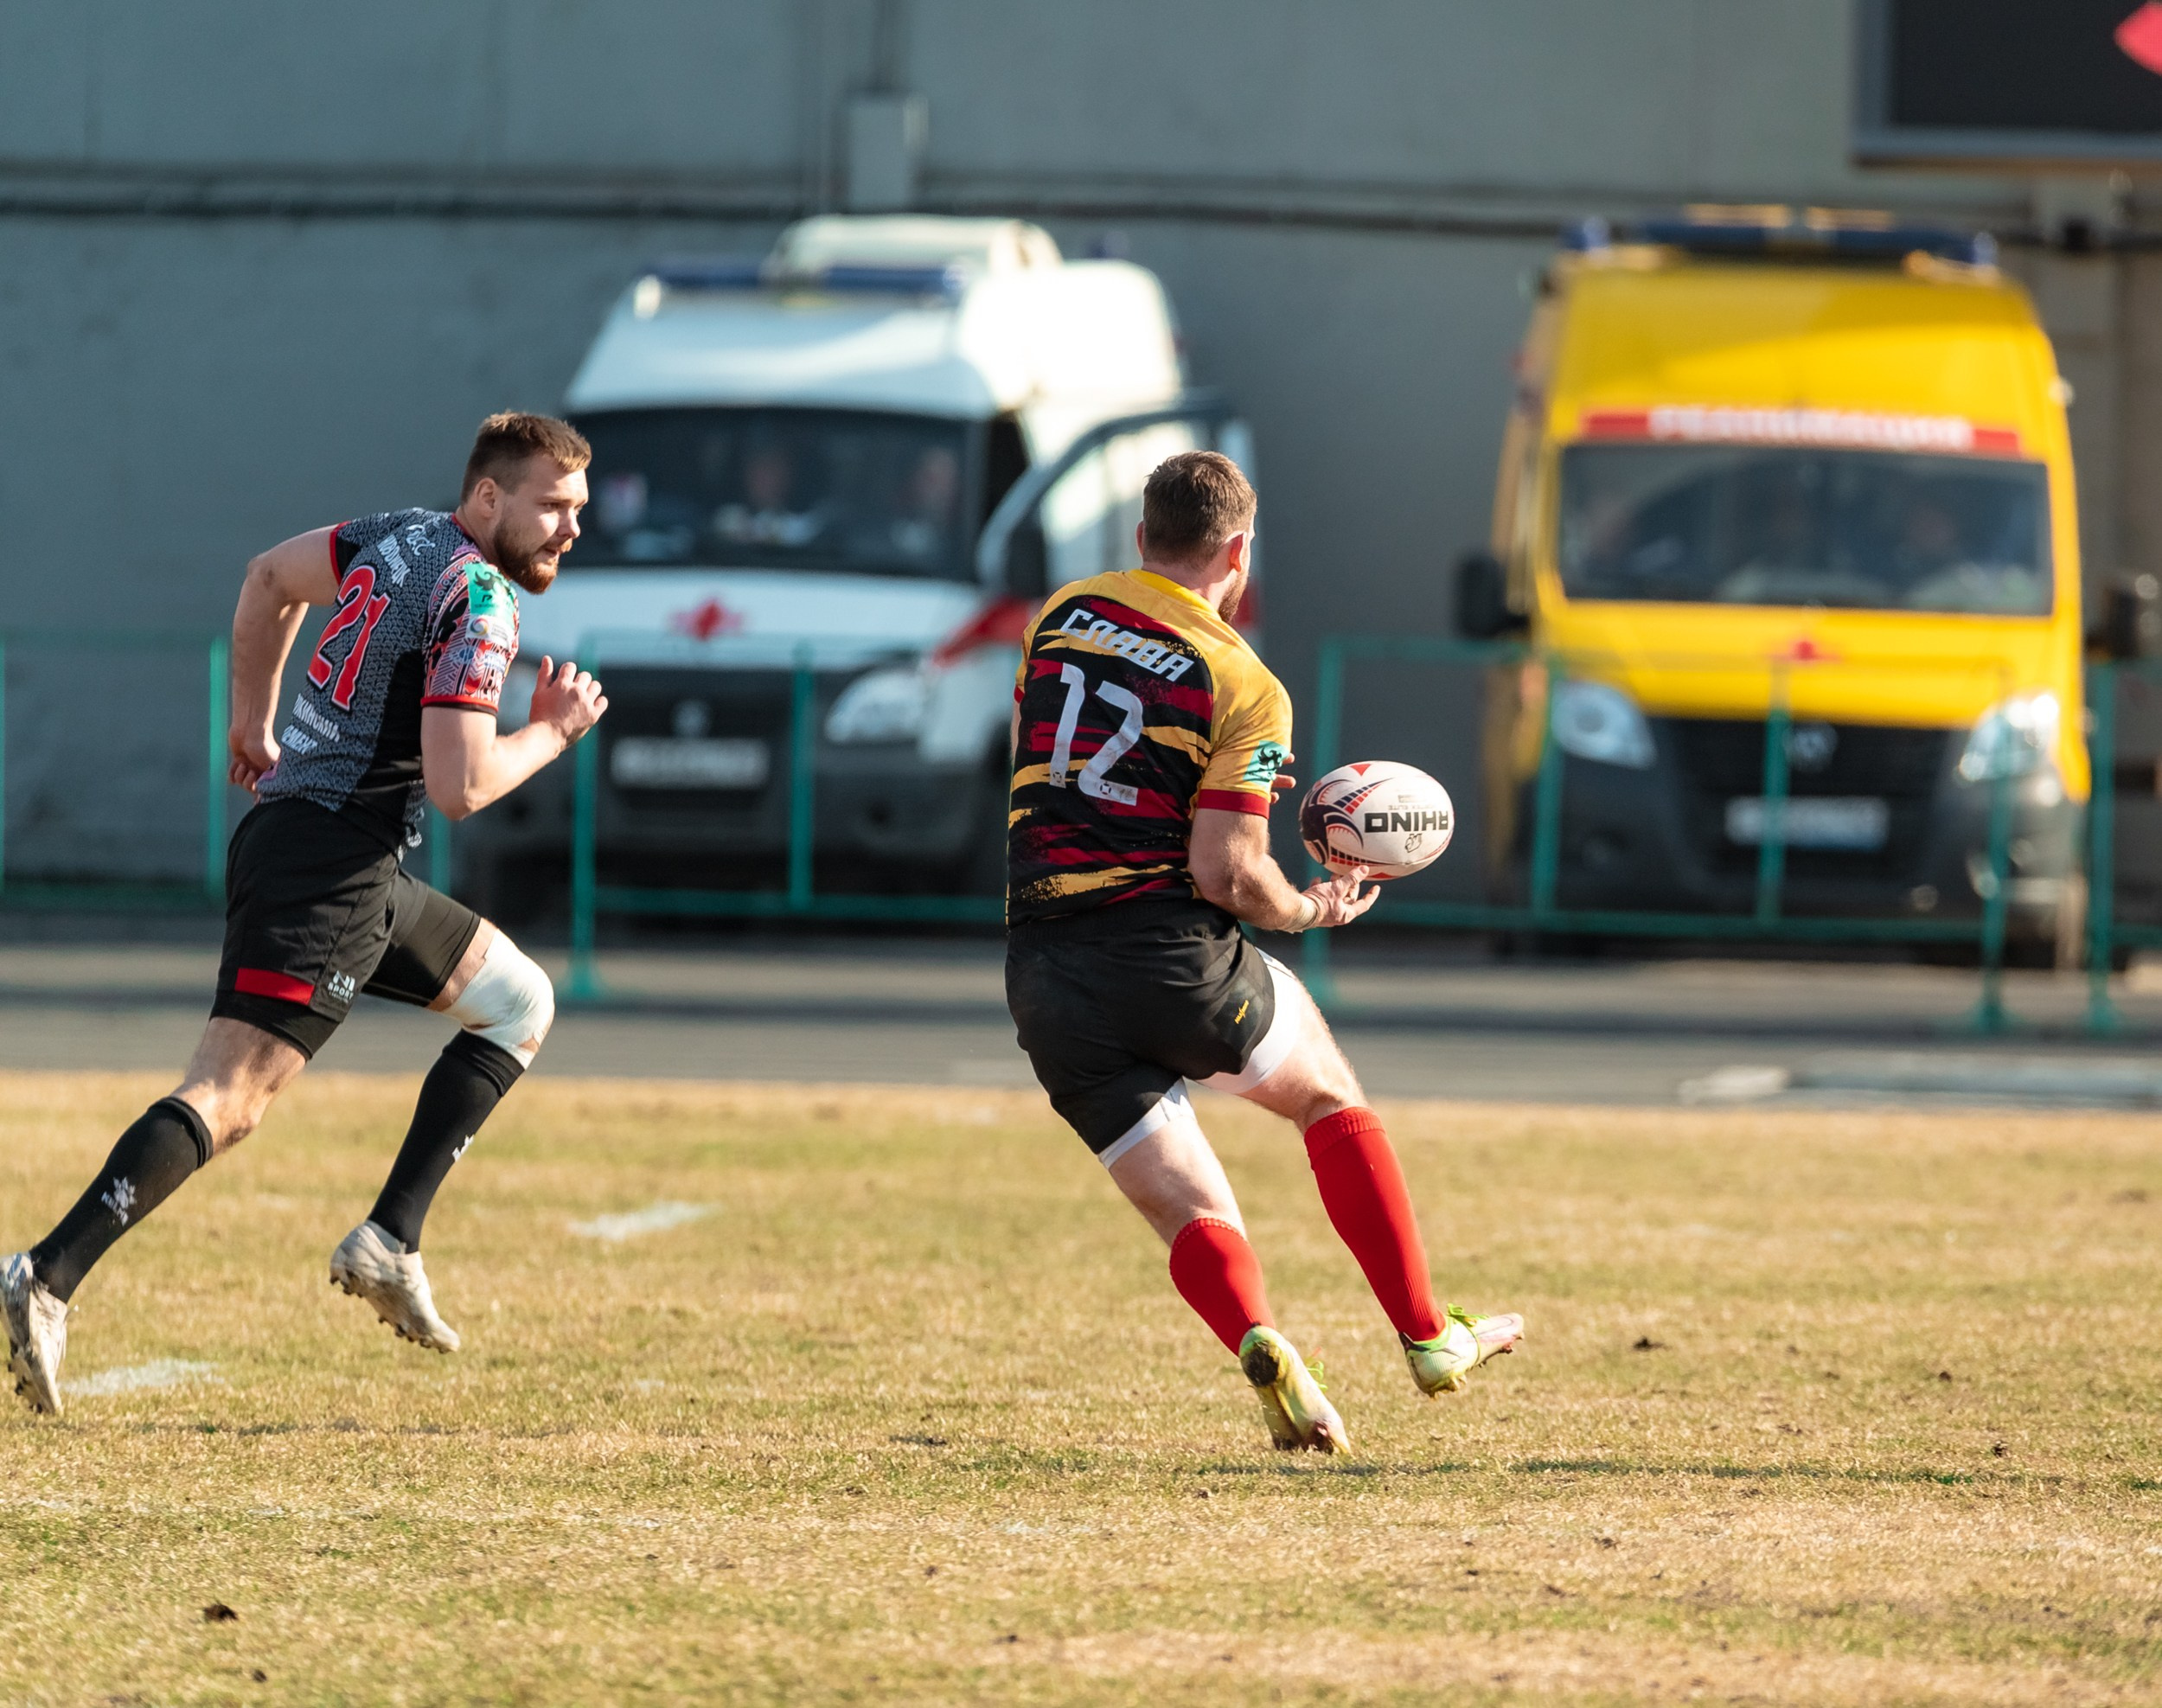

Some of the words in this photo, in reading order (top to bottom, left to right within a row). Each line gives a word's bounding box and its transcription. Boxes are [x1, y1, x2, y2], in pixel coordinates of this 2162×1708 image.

[307, 565, 391, 712] 21
[1060, 608, 1194, 681] СЛАВА
[1049, 662, 1145, 806] 12
[1365, 811, 1449, 833] RHINO
